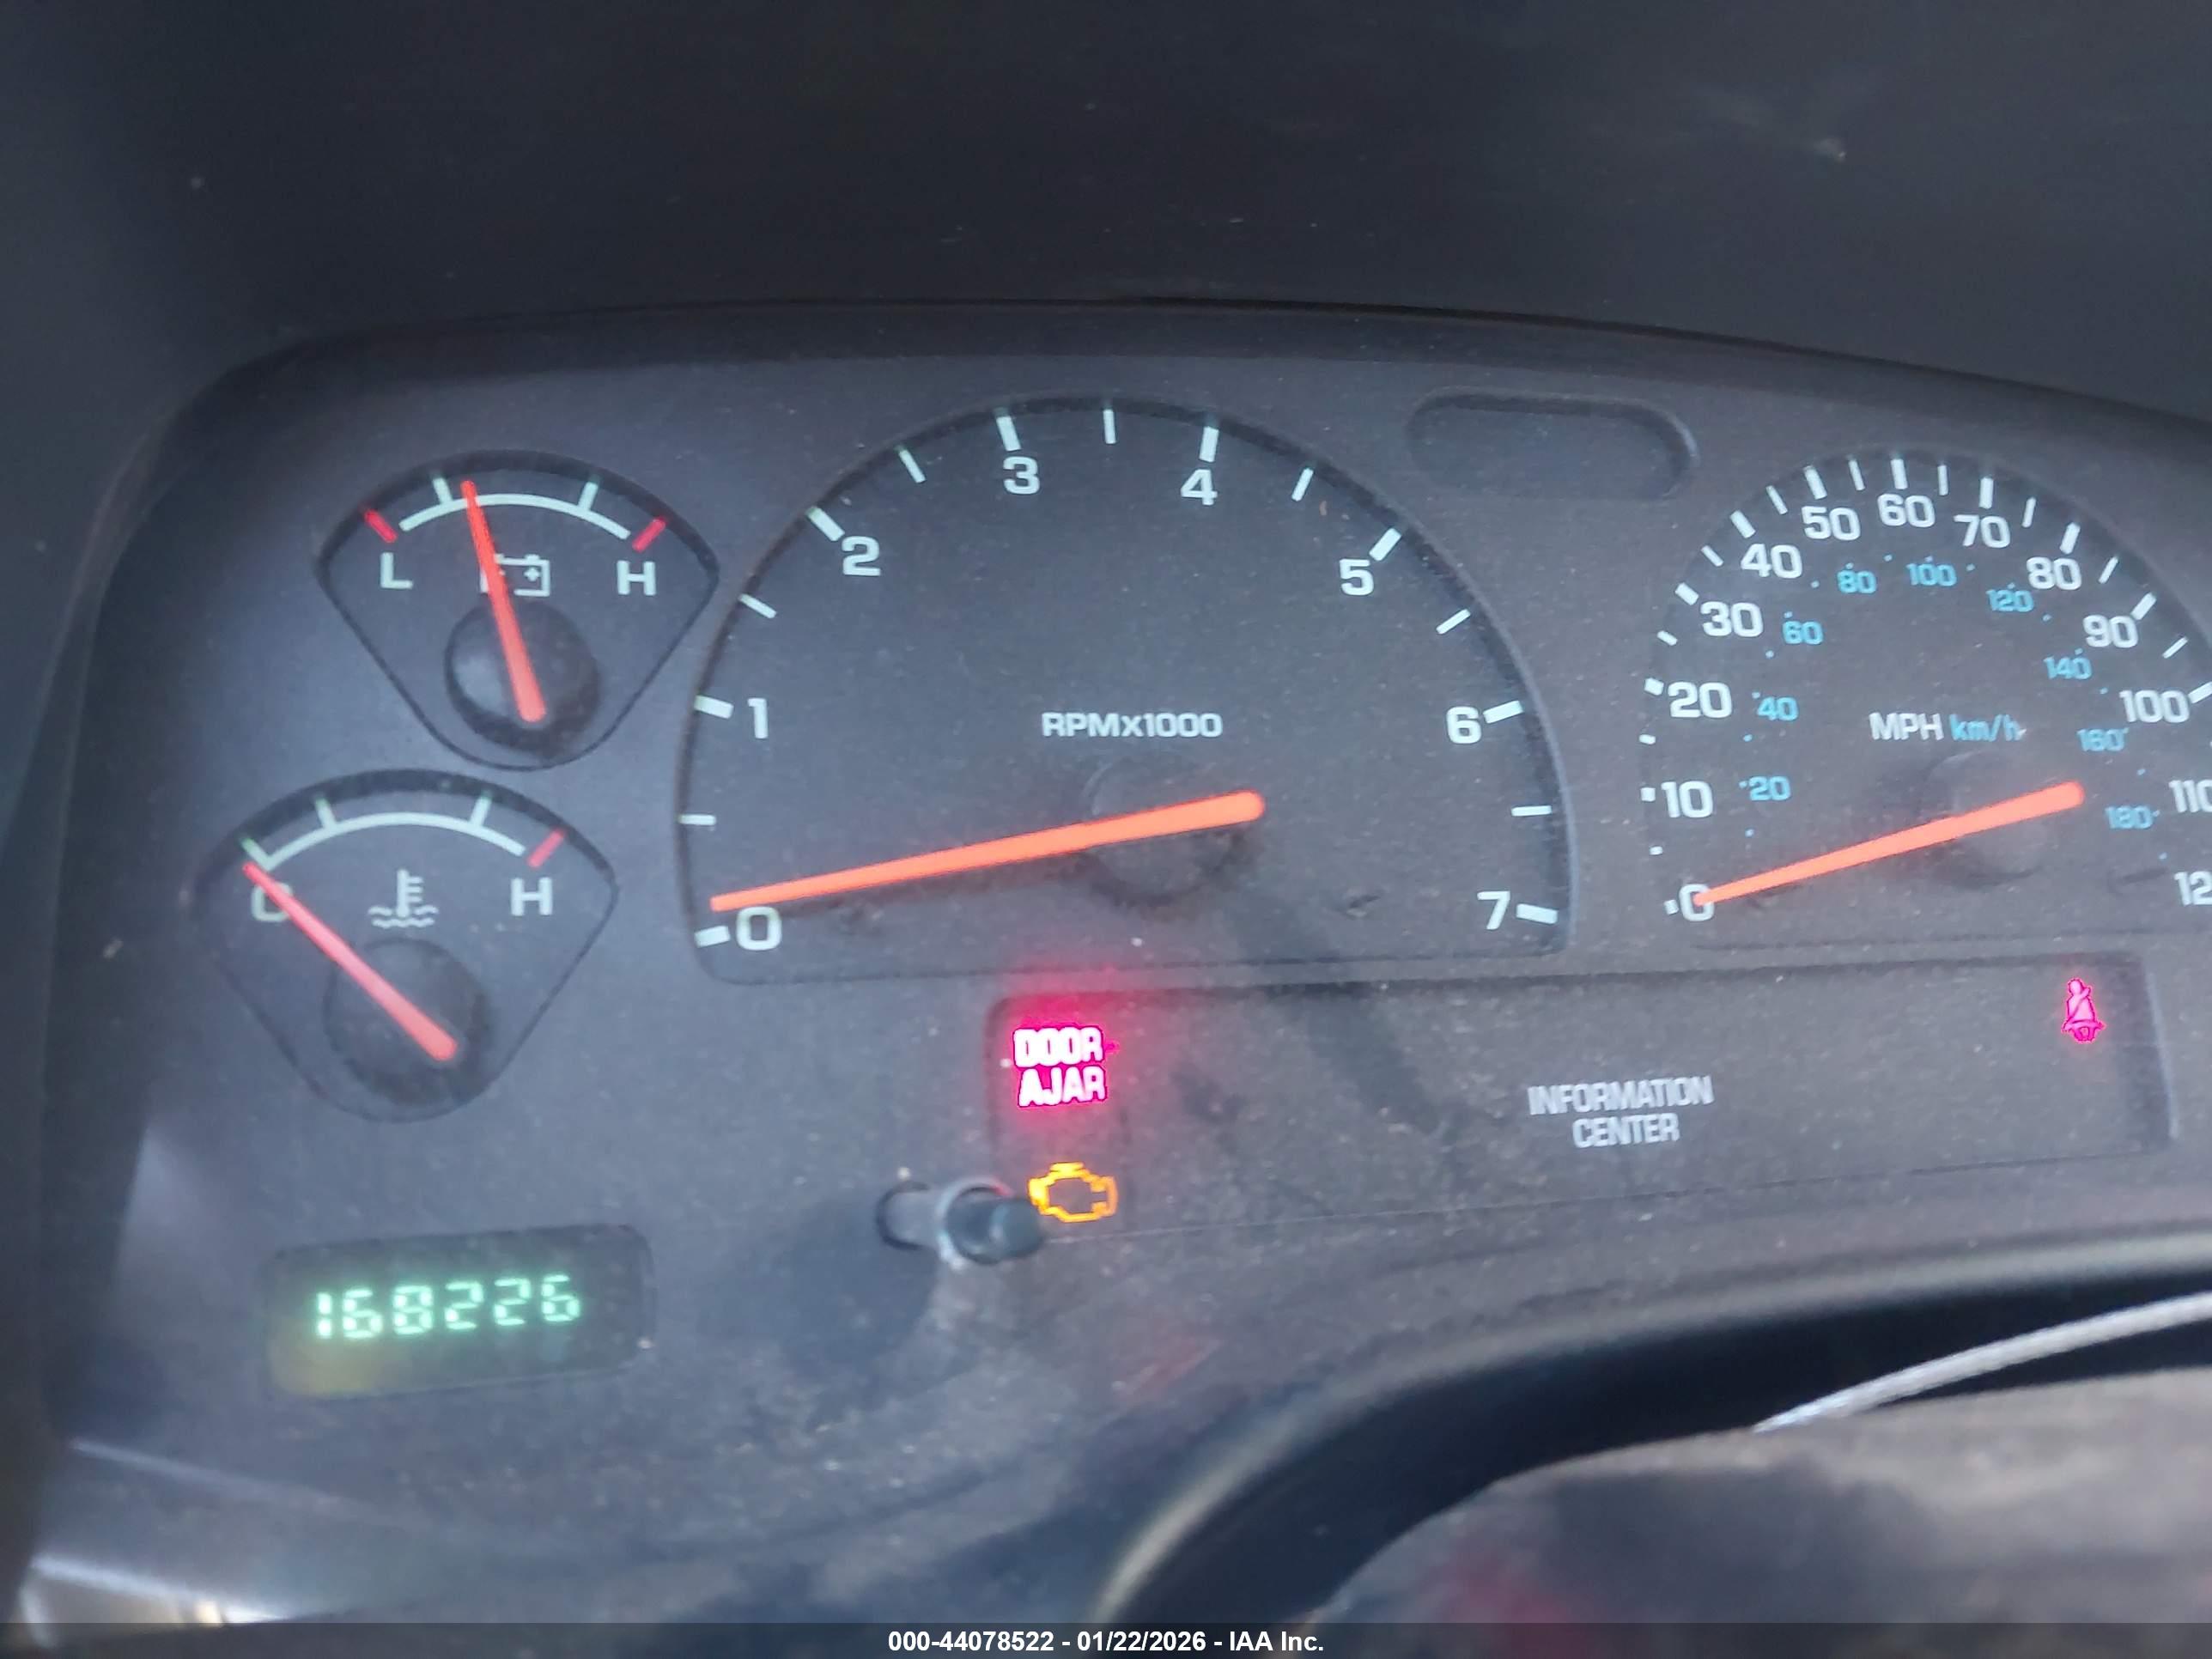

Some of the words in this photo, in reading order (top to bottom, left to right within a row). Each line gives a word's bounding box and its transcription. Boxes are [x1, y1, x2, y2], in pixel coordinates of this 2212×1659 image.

[1003, 456, 1041, 496] 3
[1180, 468, 1218, 506] 4
[1801, 506, 1861, 541] 50
[1877, 493, 1936, 528] 60
[1954, 514, 2010, 549] 70
[380, 552, 413, 590] L
[840, 535, 882, 578] 2
[1740, 543, 1802, 579] 40
[1905, 562, 1957, 587] 100
[2026, 556, 2081, 592] 80
[616, 560, 657, 596] H
[1339, 557, 1374, 597] 5
[1837, 570, 1877, 594] 80
[1699, 600, 1764, 637] 30
[1986, 588, 2034, 612] 120
[1782, 621, 1824, 646] 60
[2082, 614, 2139, 648] 90
[2044, 656, 2093, 680] 140
[749, 696, 769, 739] 1
[1668, 681, 1733, 719] 20
[1756, 696, 1799, 721] 40
[2119, 689, 2190, 723] 100
[1446, 706, 1482, 745] 6
[1869, 712, 1945, 741] MPH
[1948, 713, 2021, 742] km/h
[1661, 781, 1714, 818] 10
[1748, 775, 1791, 802] 20
[510, 877, 554, 916] H
[1476, 890, 1512, 930] 7
[1678, 882, 1715, 921] 0
[735, 906, 782, 952] 0
[1012, 1025, 1104, 1067] DOOR
[1018, 1065, 1107, 1107] AJAR
[1527, 1075, 1715, 1115] INFORMATION
[1571, 1112, 1681, 1148] CENTER
[314, 1273, 582, 1340] 168226
